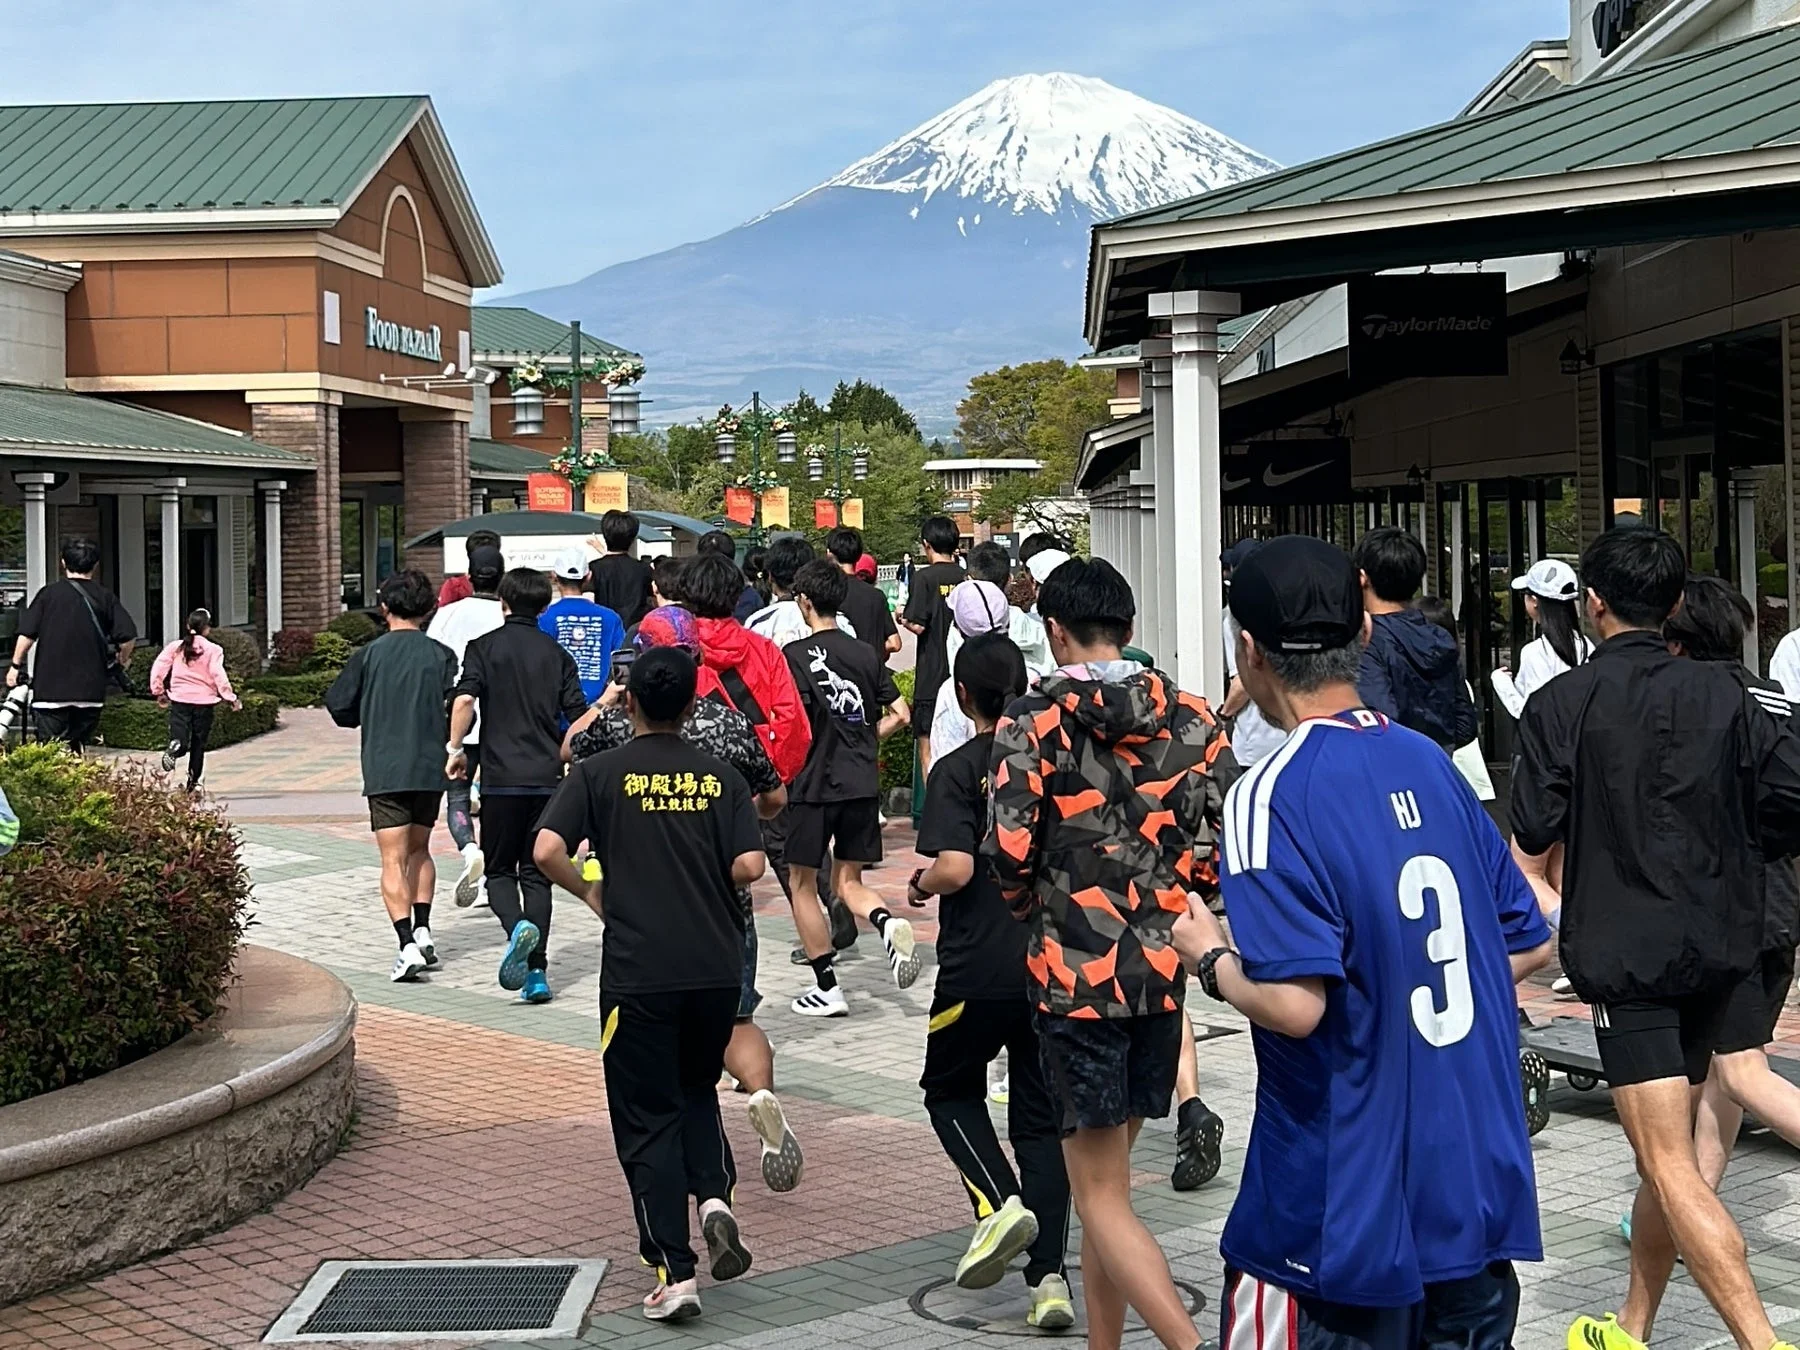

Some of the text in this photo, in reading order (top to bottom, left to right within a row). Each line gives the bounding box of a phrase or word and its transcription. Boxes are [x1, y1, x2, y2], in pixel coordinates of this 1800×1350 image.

[366, 306, 442, 361] FOOD BAZAAR
[1361, 314, 1492, 339] TaylorMade
[624, 772, 722, 797] 御殿場南
[641, 796, 709, 812] 陸上競技部
[1398, 855, 1475, 1048] 3
